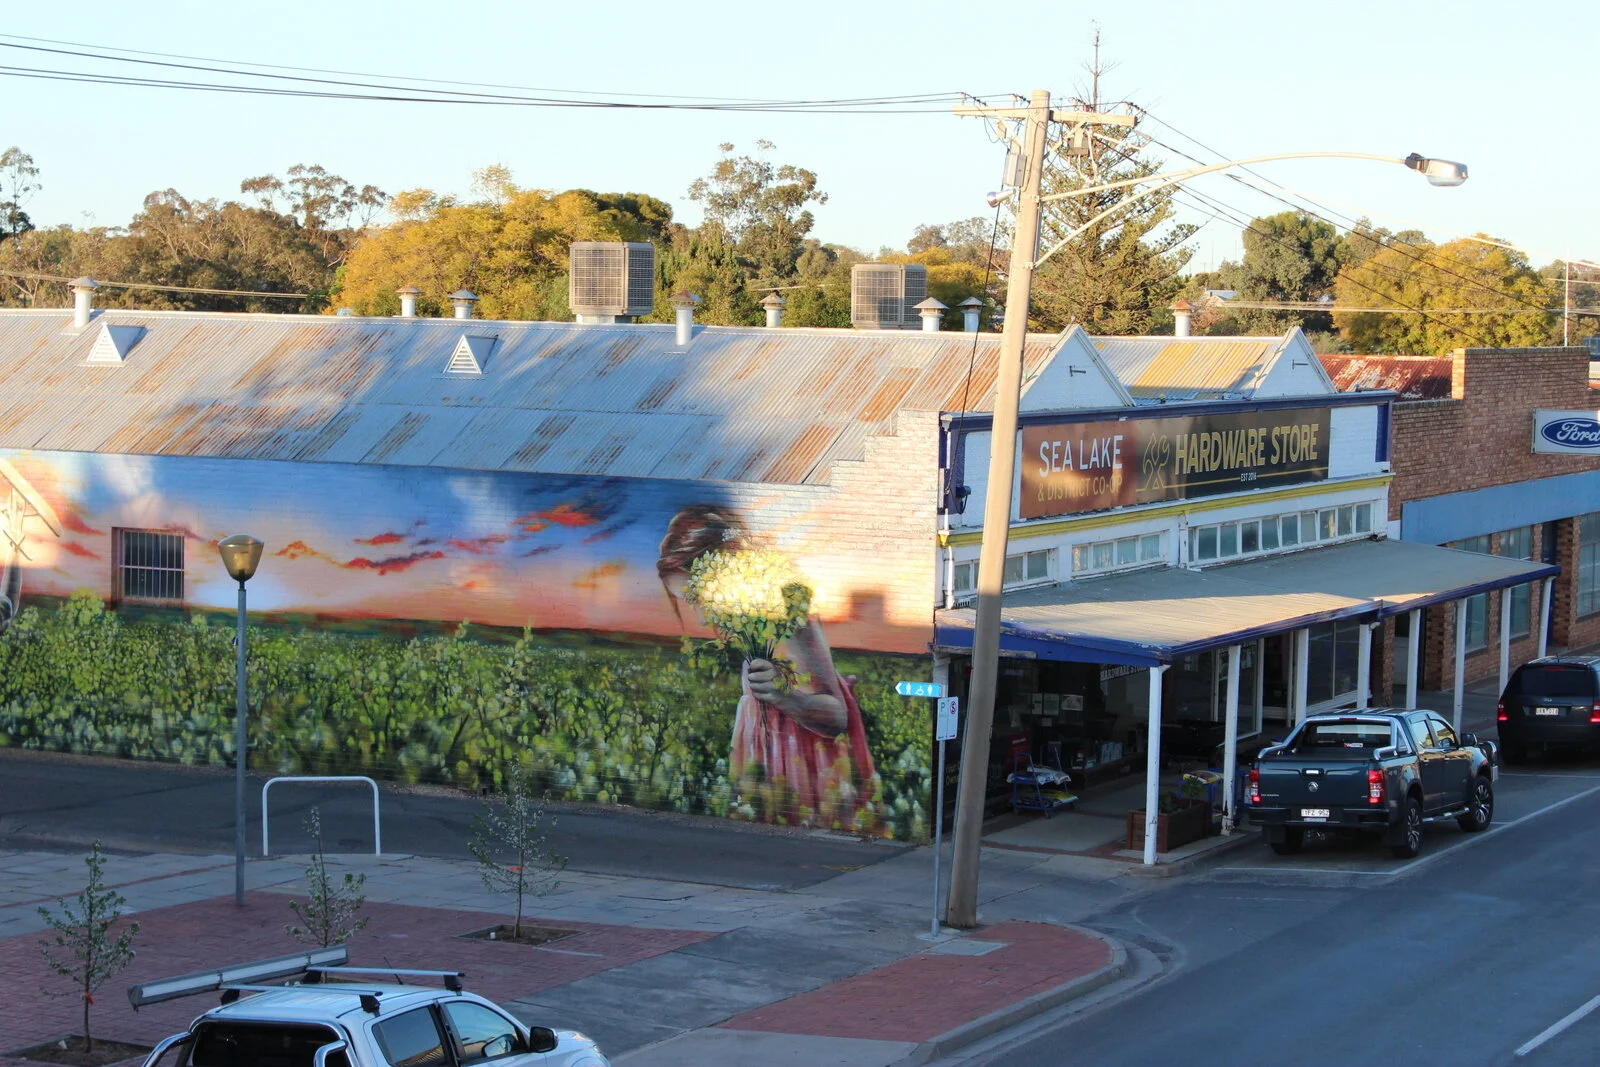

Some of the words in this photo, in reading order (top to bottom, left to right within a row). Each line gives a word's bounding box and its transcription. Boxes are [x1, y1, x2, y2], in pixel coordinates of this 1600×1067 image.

[1556, 421, 1600, 441] Ford
[1039, 440, 1073, 478] SEA
[1079, 435, 1124, 470] LAKE
[1175, 427, 1267, 475] HARDWARE
[1270, 423, 1319, 465] STORE
[1047, 478, 1091, 500] DISTRICT
[1092, 475, 1124, 496] CO-OP
[1240, 472, 1248, 482] EST
[940, 702, 946, 713] P
